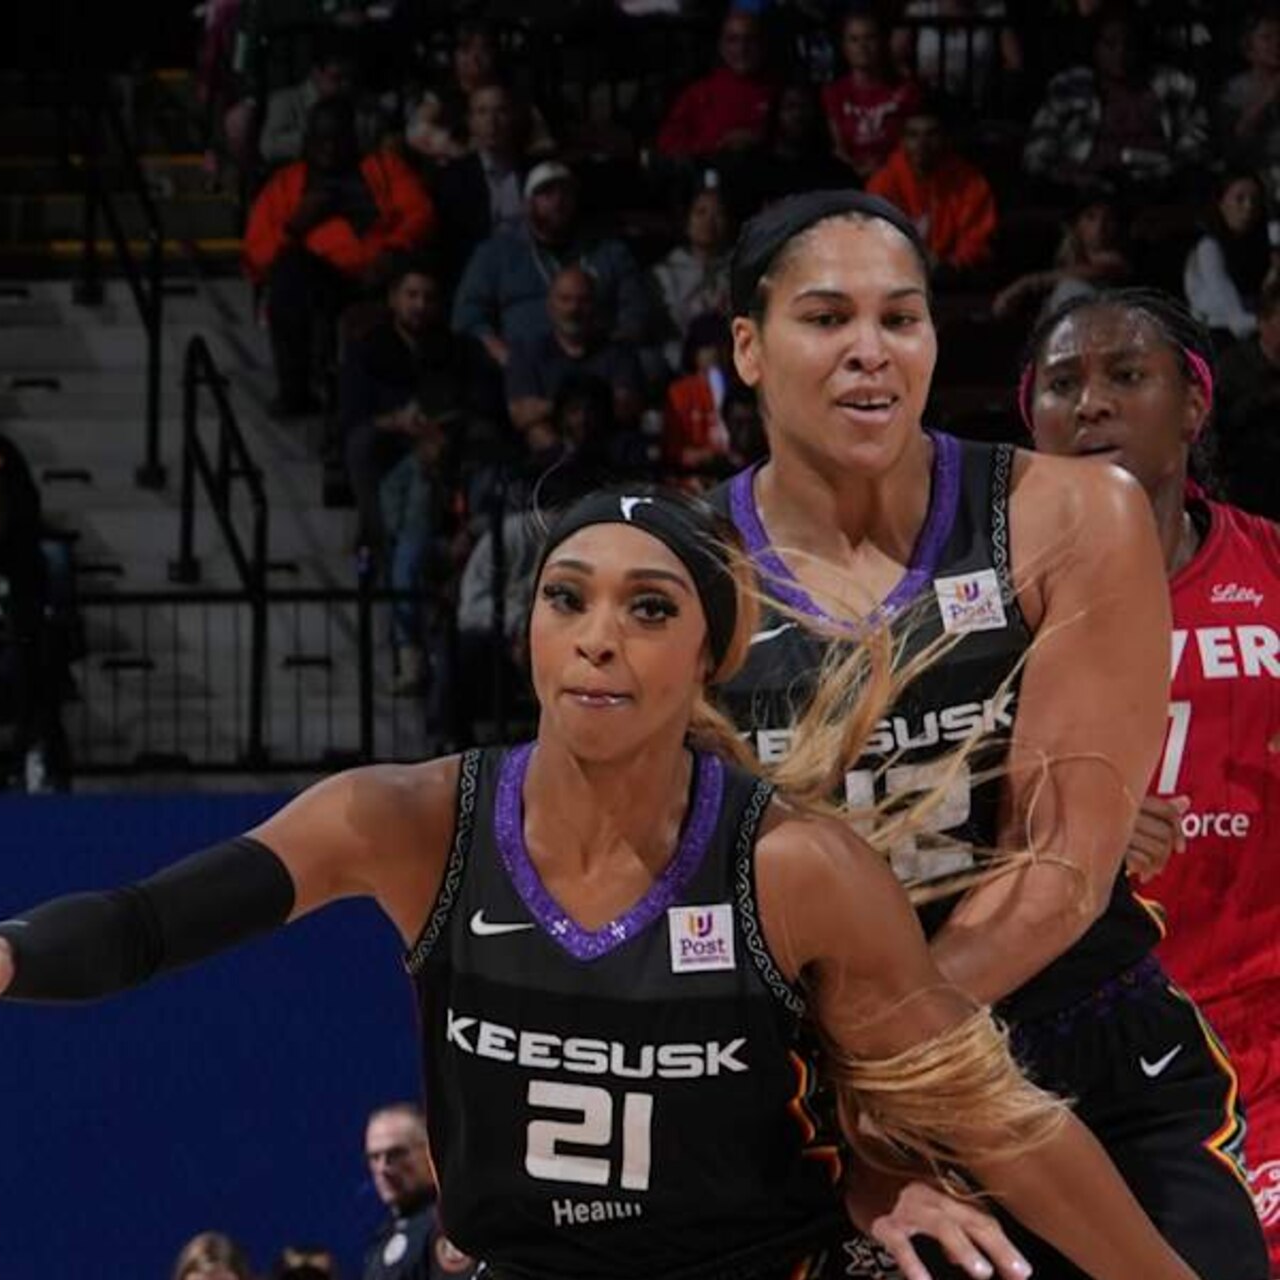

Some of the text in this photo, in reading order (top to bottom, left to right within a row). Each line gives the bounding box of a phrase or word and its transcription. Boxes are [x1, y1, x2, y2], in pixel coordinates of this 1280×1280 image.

[1210, 582, 1264, 609] Lilly
[679, 938, 727, 956] Post
[446, 1008, 750, 1079] KEESUSK
[525, 1079, 654, 1191] 21
